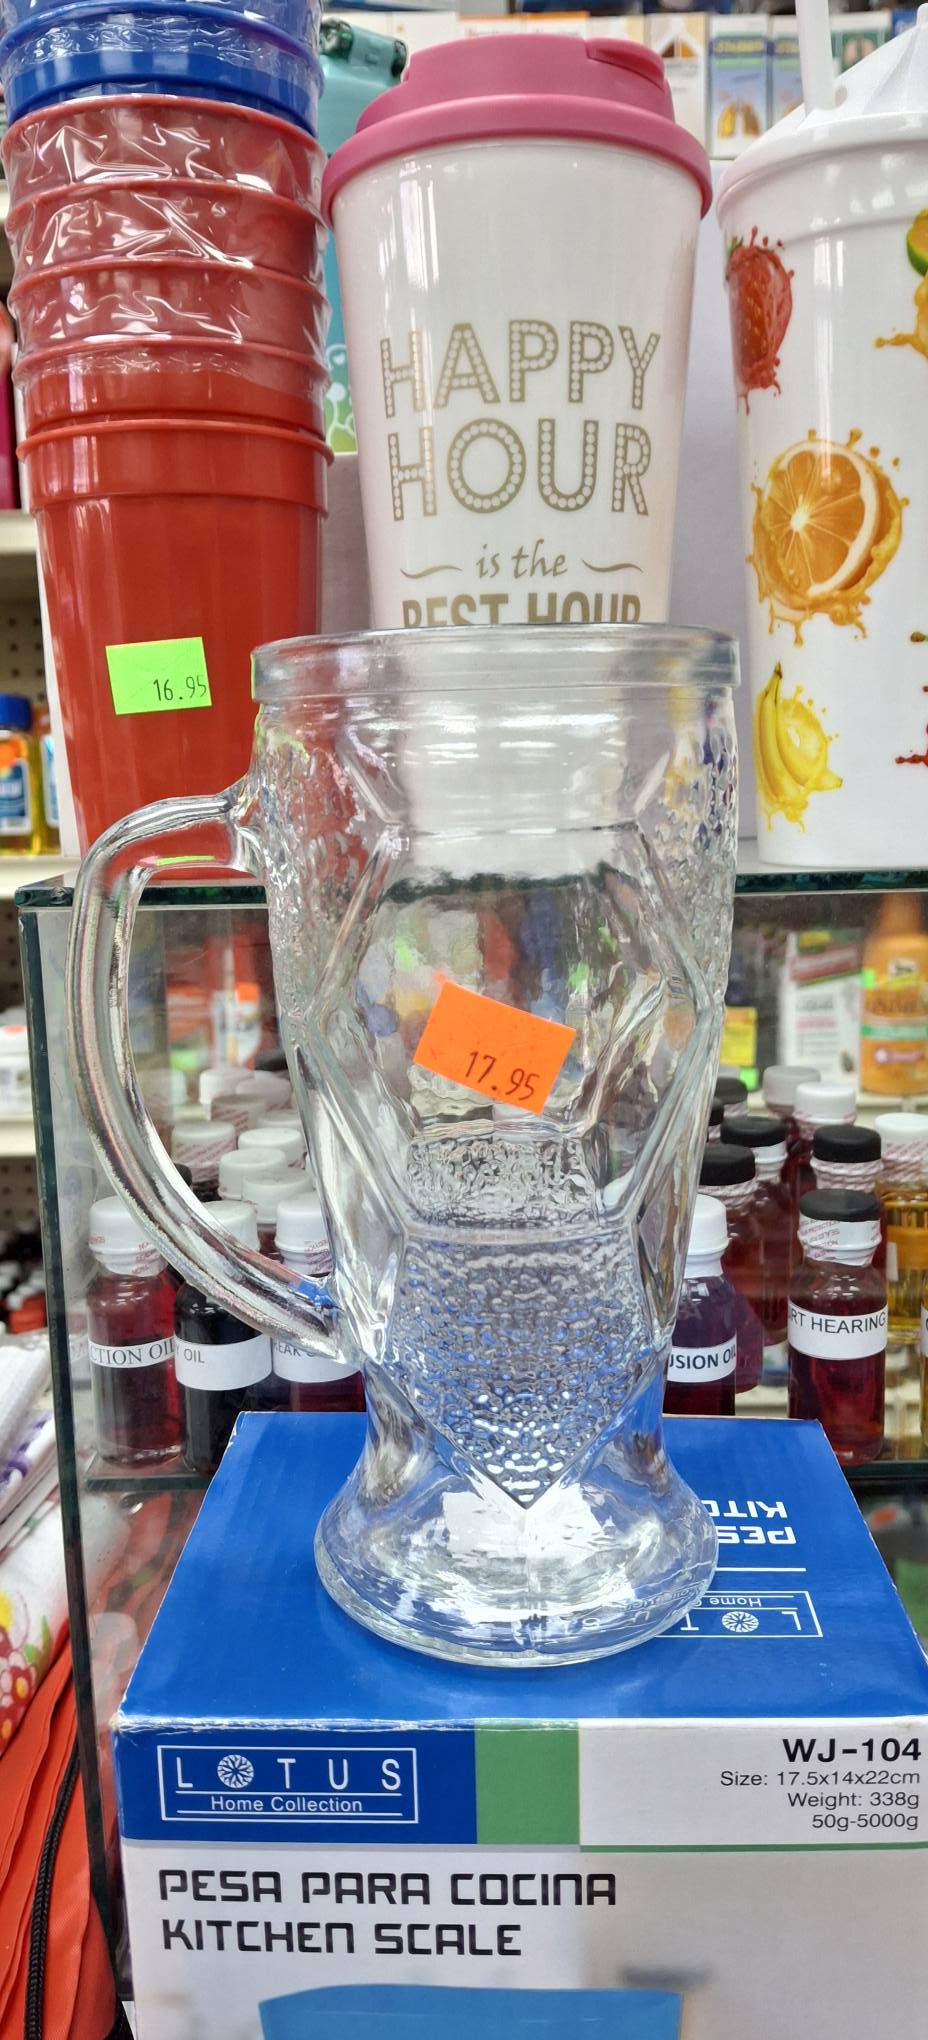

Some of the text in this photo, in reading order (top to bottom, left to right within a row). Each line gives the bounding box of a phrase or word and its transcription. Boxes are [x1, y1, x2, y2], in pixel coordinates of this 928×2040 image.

[380, 319, 661, 419] HAPPY
[387, 418, 652, 522] HOUR
[475, 538, 569, 579] is the
[153, 674, 207, 701] 16.95
[465, 1051, 540, 1101] 17.95
[811, 1311, 886, 1334] HEARING
[184, 1348, 205, 1363] OIL
[717, 1525, 797, 1545] PES
[782, 1737, 922, 1763] WJ-104
[176, 1754, 401, 1791] LOTUS
[720, 1770, 920, 1786] Size: 17.5x14x22cm
[211, 1796, 362, 1812] Home Collection
[788, 1791, 919, 1810] Weight: 338g
[812, 1813, 919, 1832] 50g-5000g
[158, 1869, 617, 1906] PESA PARA COCINA
[162, 1919, 522, 1956] KITCHEN SCALE
